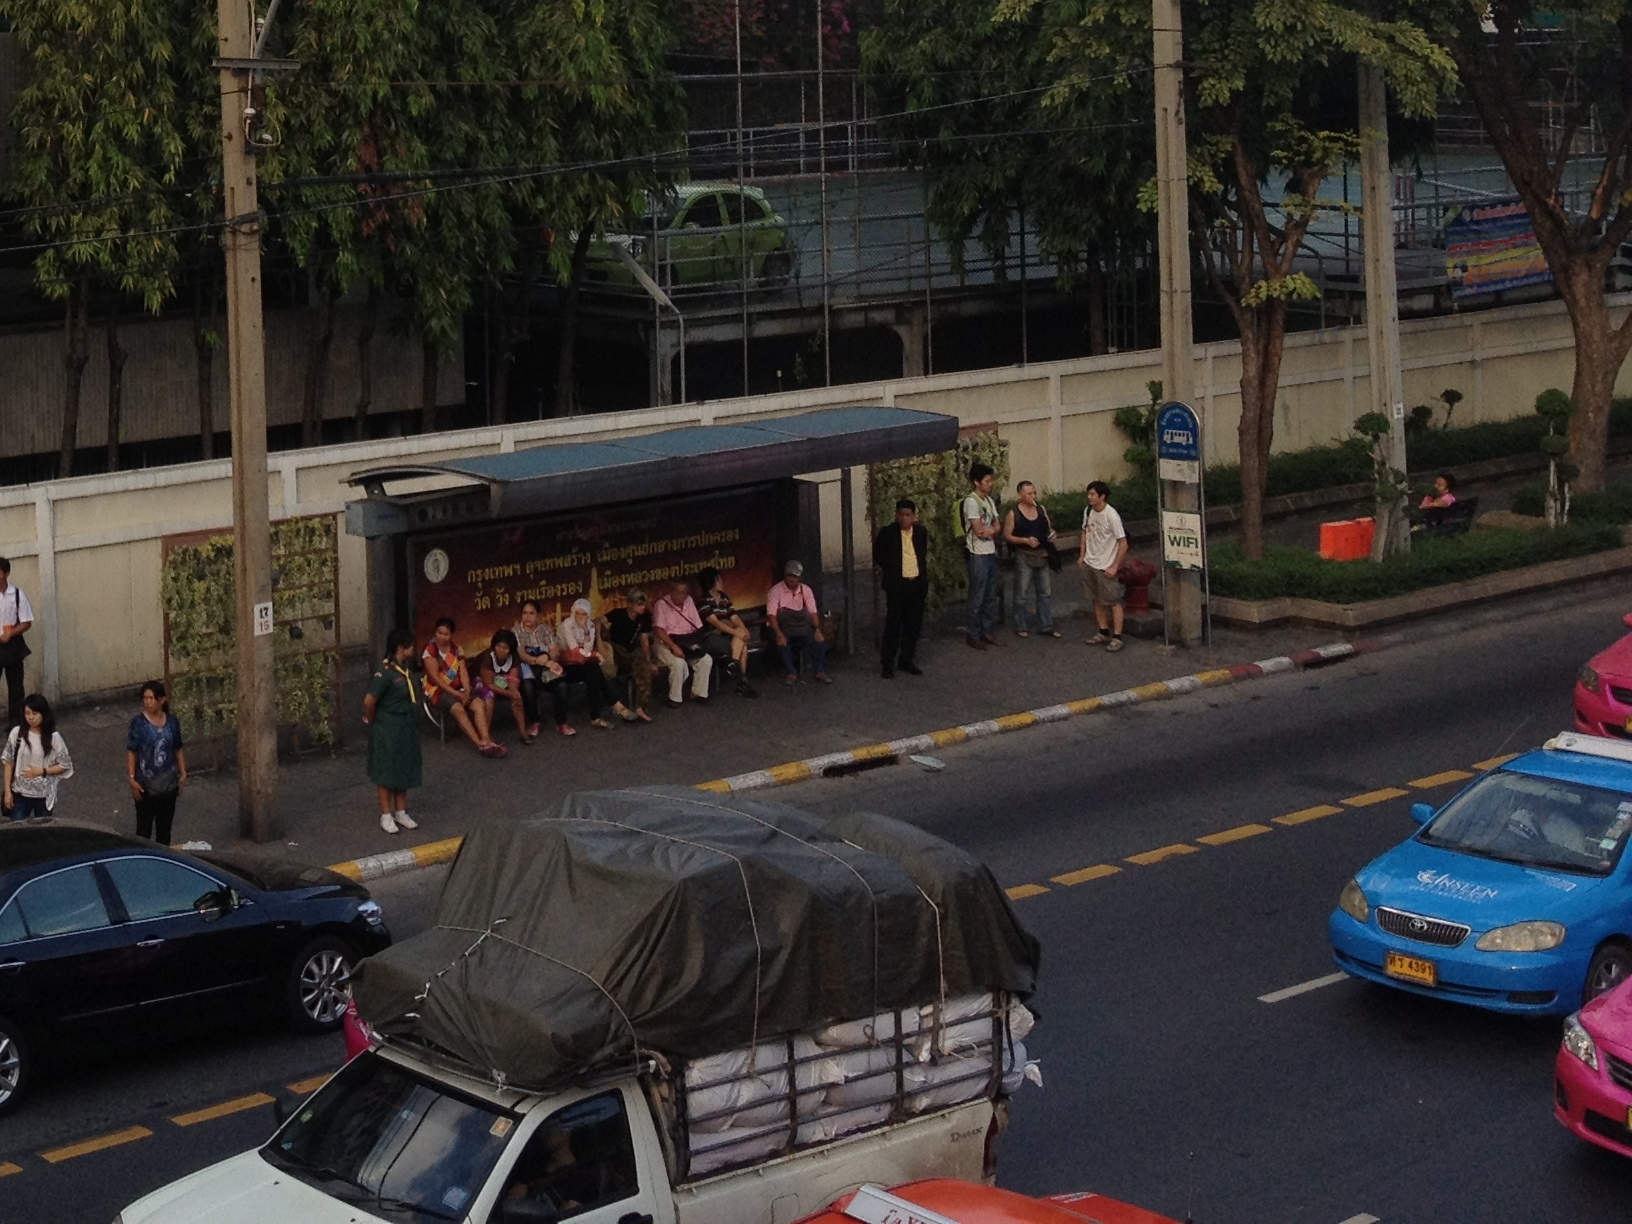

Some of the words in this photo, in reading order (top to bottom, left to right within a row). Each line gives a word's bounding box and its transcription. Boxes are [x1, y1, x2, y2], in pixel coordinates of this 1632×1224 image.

[1168, 534, 1198, 549] WIFI
[467, 563, 521, 588] กรุงเทพฯ
[474, 590, 491, 611] วัด
[495, 586, 510, 607] วัง
